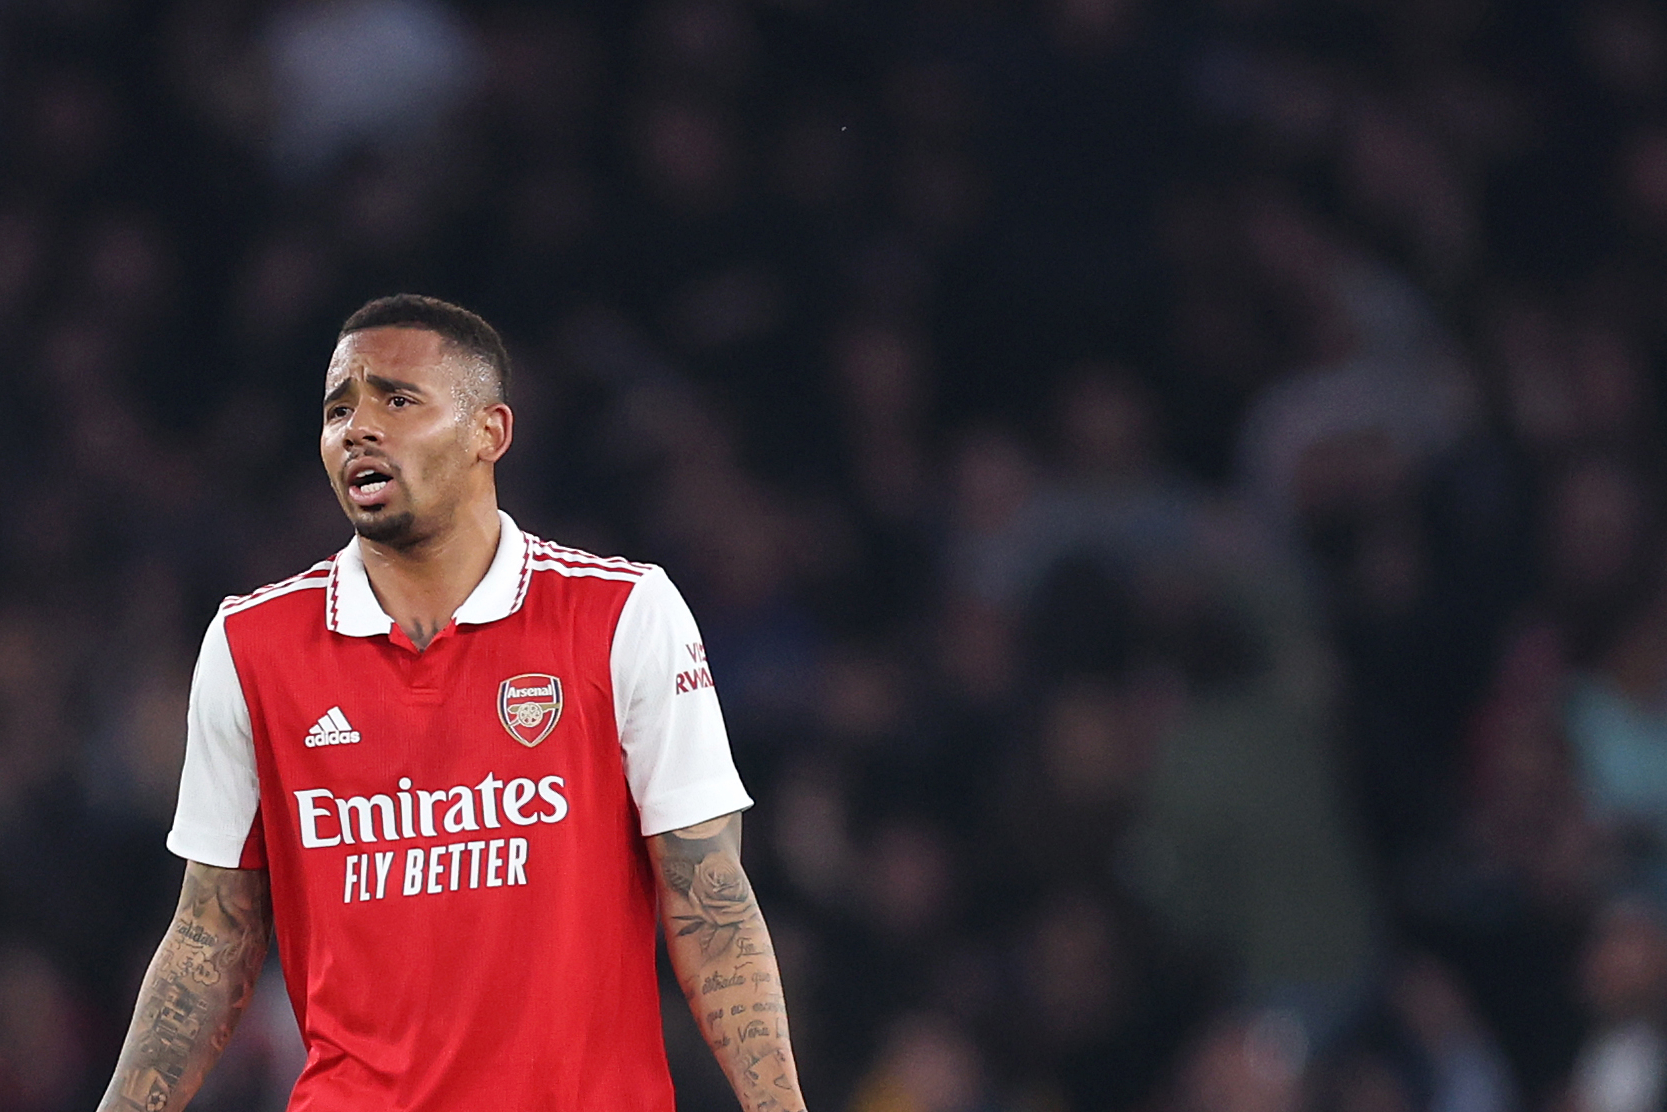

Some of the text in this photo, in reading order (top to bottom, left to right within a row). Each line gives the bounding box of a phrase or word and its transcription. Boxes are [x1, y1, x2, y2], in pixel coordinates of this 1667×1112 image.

[507, 684, 553, 699] Arsenal
[304, 730, 361, 748] adidas
[293, 771, 568, 849] Emirates
[343, 837, 529, 904] FLY BETTER
